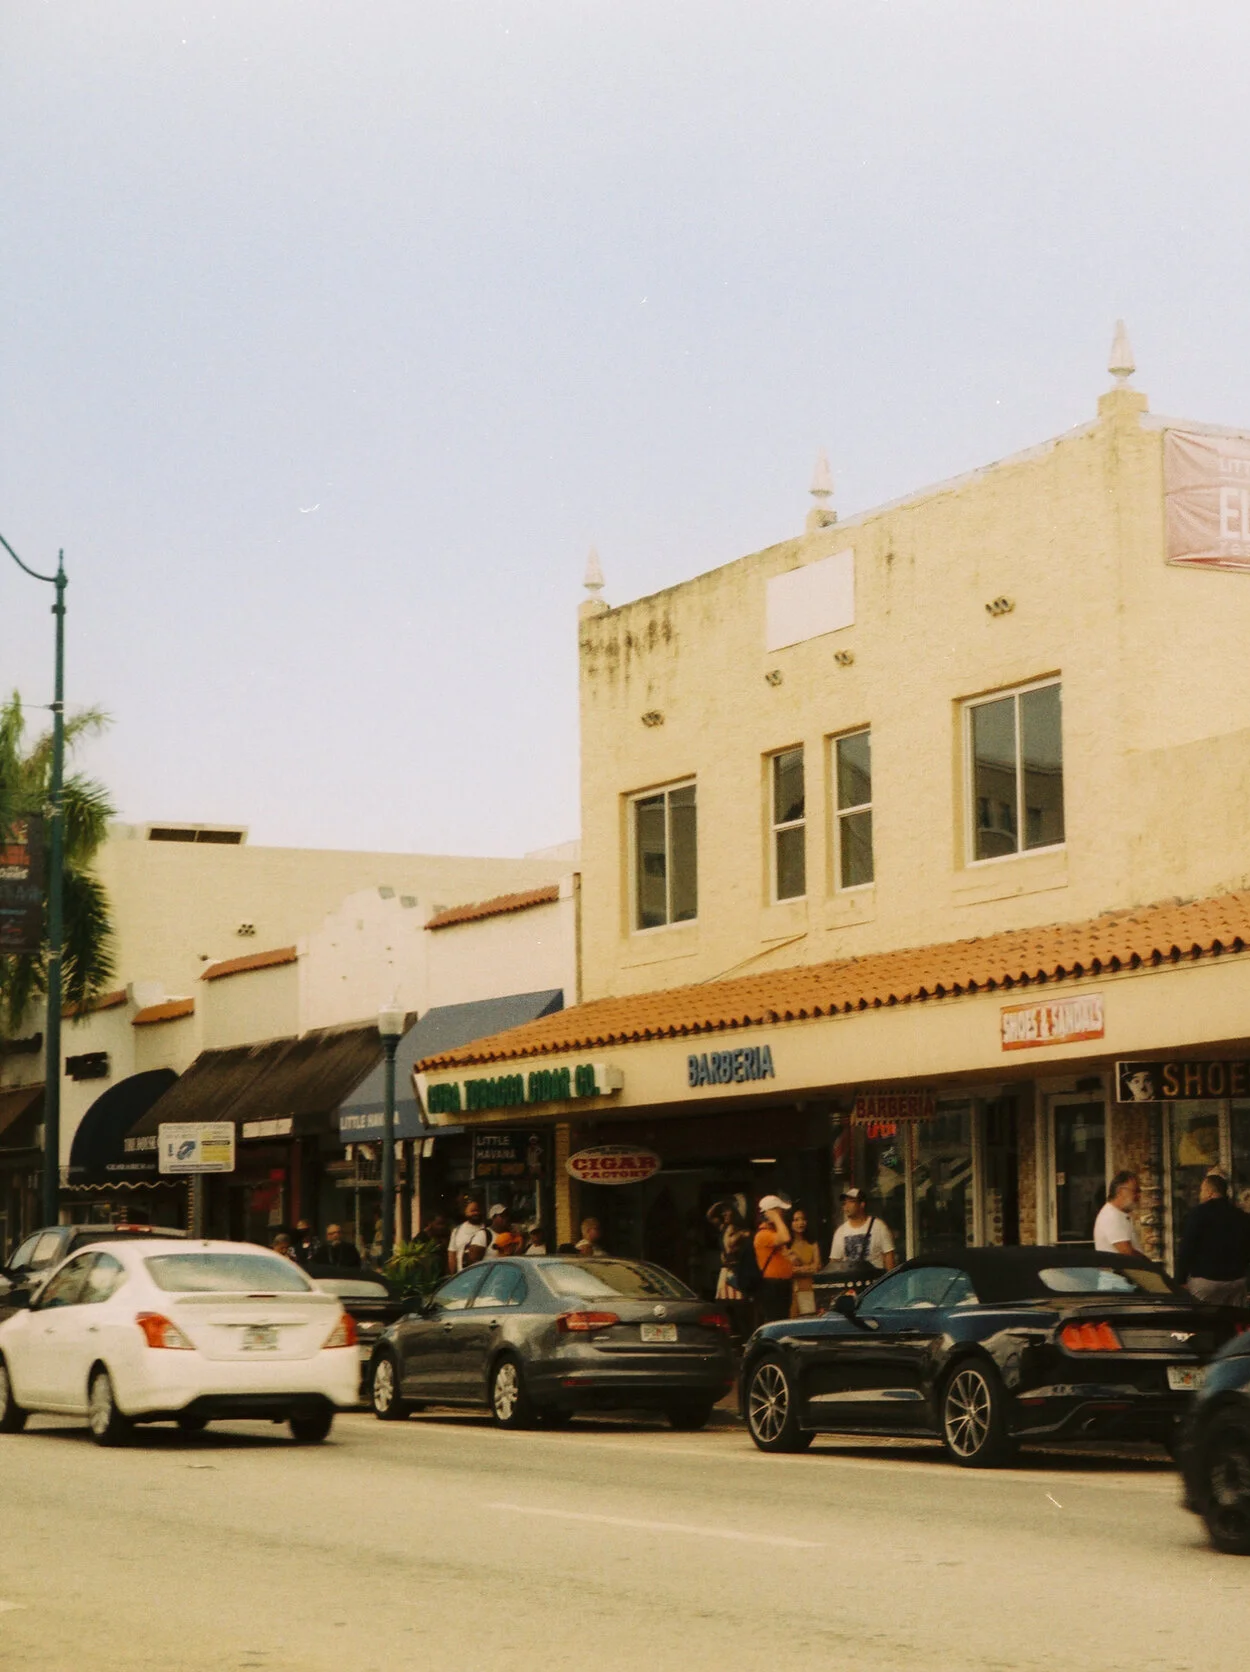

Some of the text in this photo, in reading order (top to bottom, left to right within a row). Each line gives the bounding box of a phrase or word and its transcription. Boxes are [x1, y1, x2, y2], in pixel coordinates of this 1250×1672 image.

[687, 1045, 775, 1088] BARBERIA
[856, 1095, 935, 1118] BARBERIA
[475, 1135, 512, 1146] LITTLE
[571, 1156, 657, 1171] CIGAR
[581, 1170, 651, 1179] FACTORY
